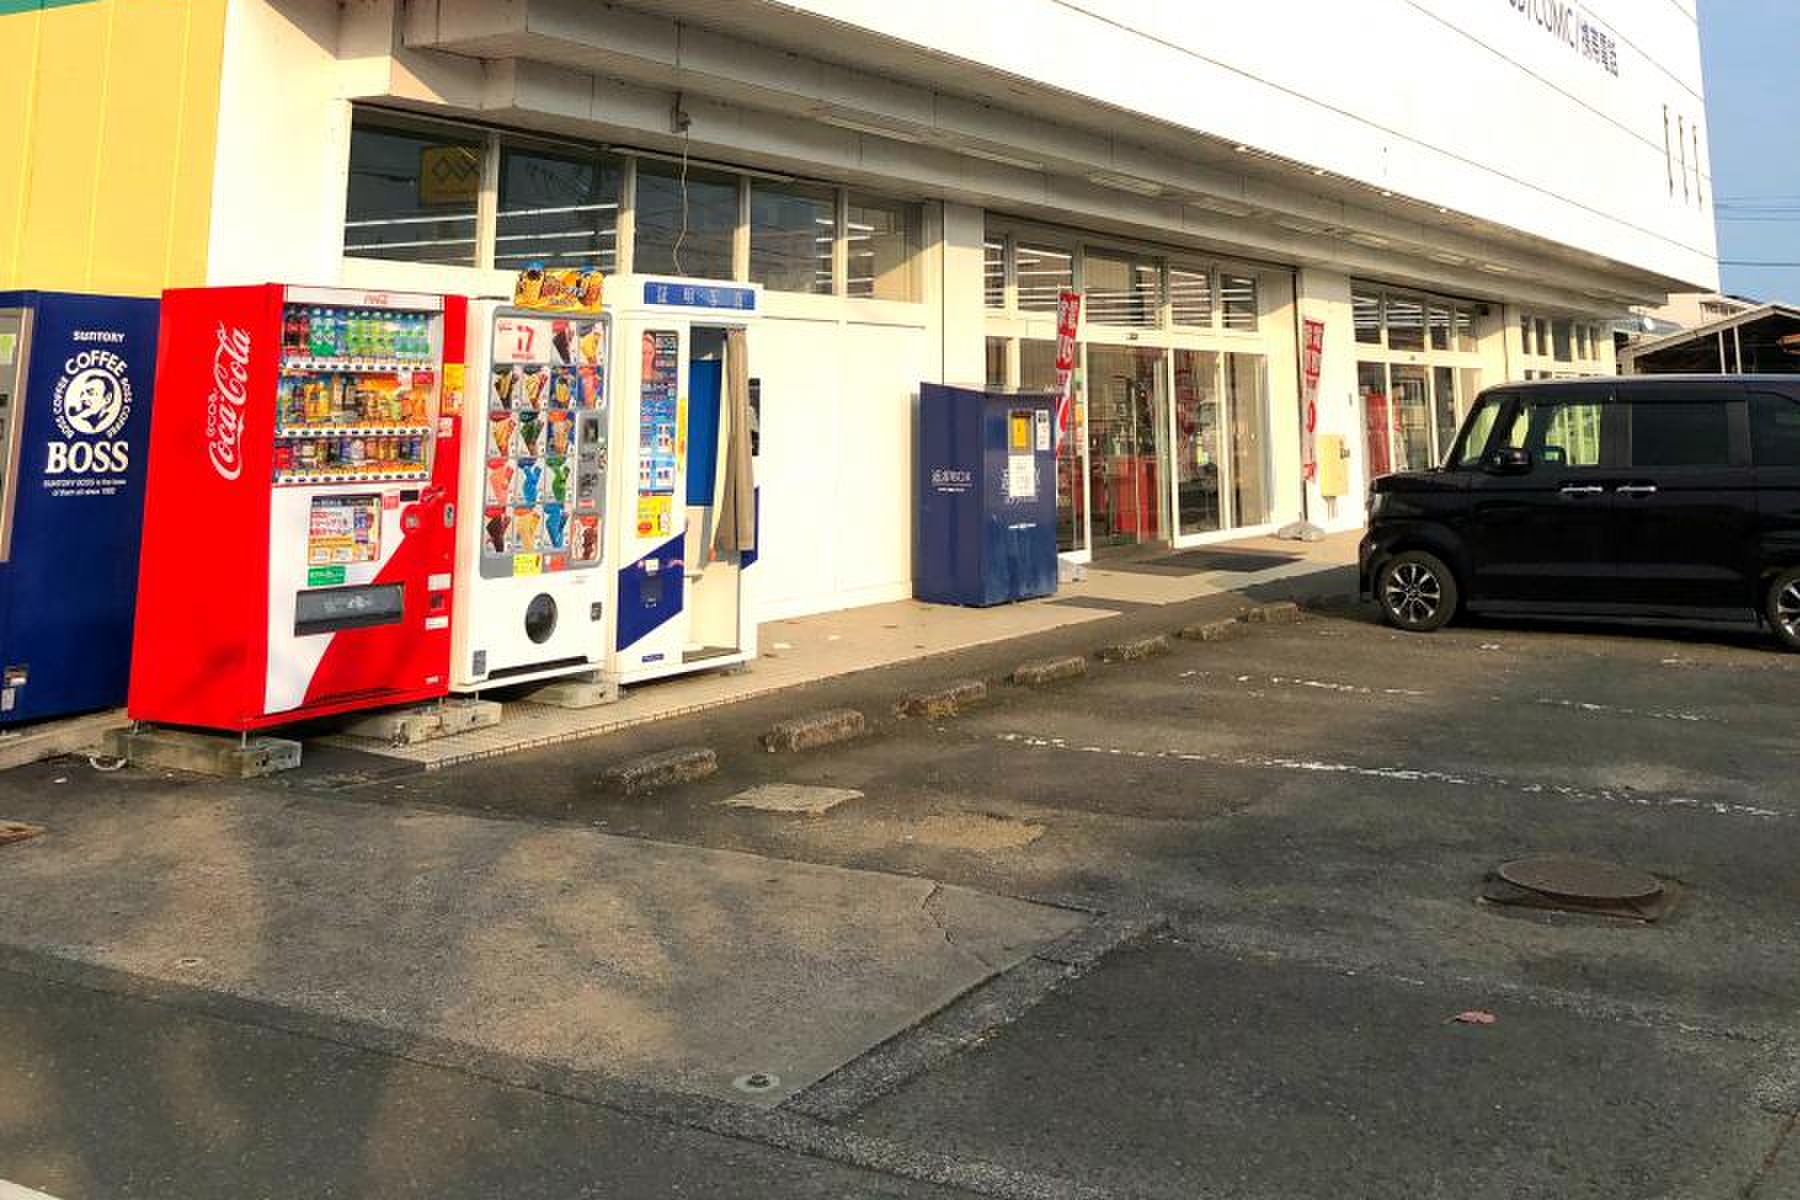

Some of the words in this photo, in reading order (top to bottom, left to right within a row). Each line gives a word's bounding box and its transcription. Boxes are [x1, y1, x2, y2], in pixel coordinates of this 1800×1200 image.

[72, 330, 126, 344] SUNTORY
[64, 350, 128, 378] COFFEE
[208, 320, 251, 481] Coca-Cola
[44, 440, 129, 474] BOSS
